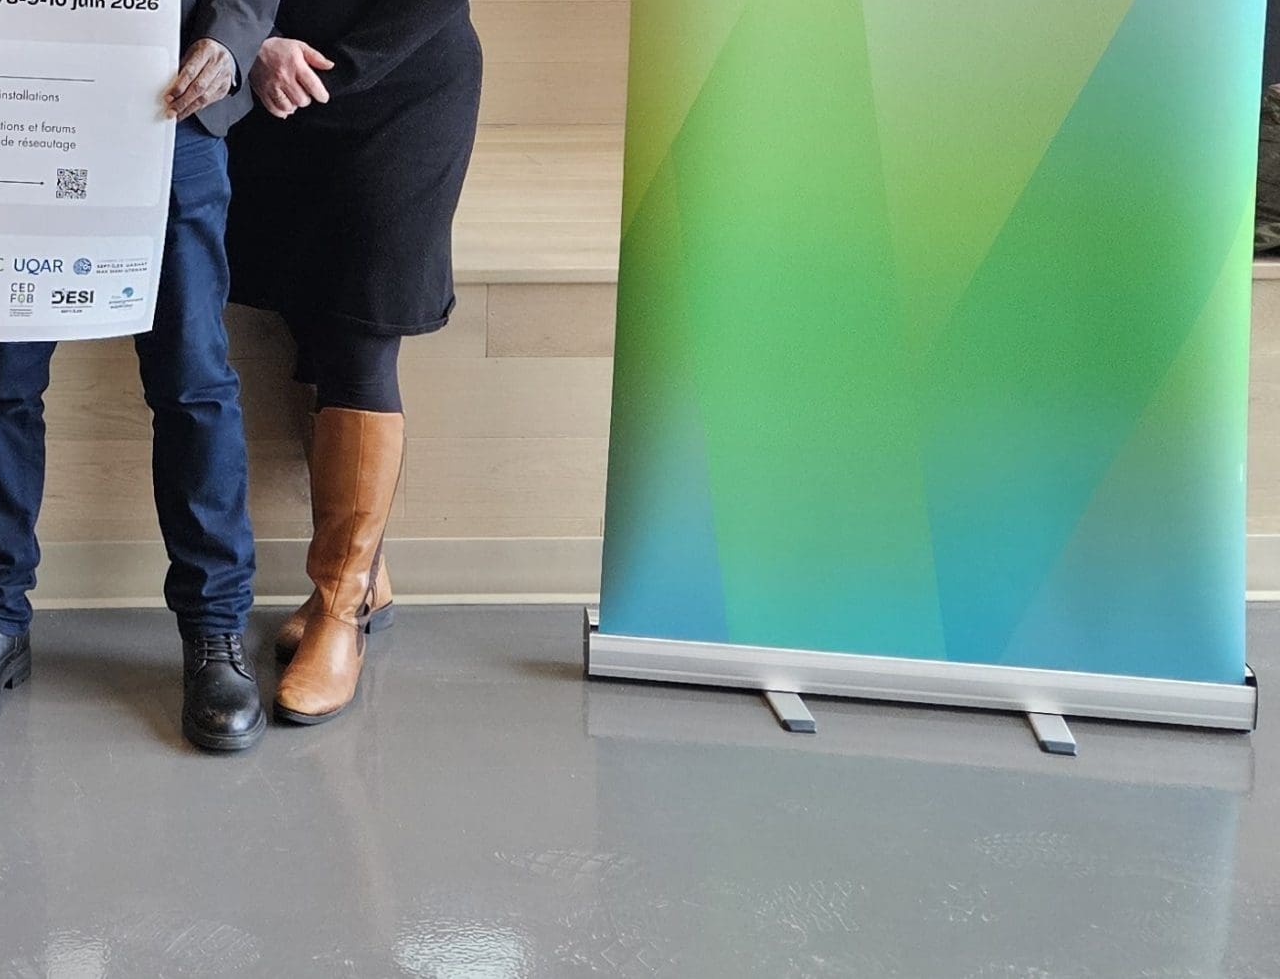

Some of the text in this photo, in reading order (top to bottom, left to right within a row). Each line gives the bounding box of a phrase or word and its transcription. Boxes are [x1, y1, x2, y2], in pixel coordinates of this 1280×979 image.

[28, 123, 38, 132] et
[41, 122, 77, 134] forums
[1, 136, 15, 147] de
[18, 137, 77, 152] réseautage
[13, 257, 64, 275] UQAR
[10, 282, 36, 293] CED
[10, 293, 35, 303] FOB
[51, 287, 95, 305] DESI
